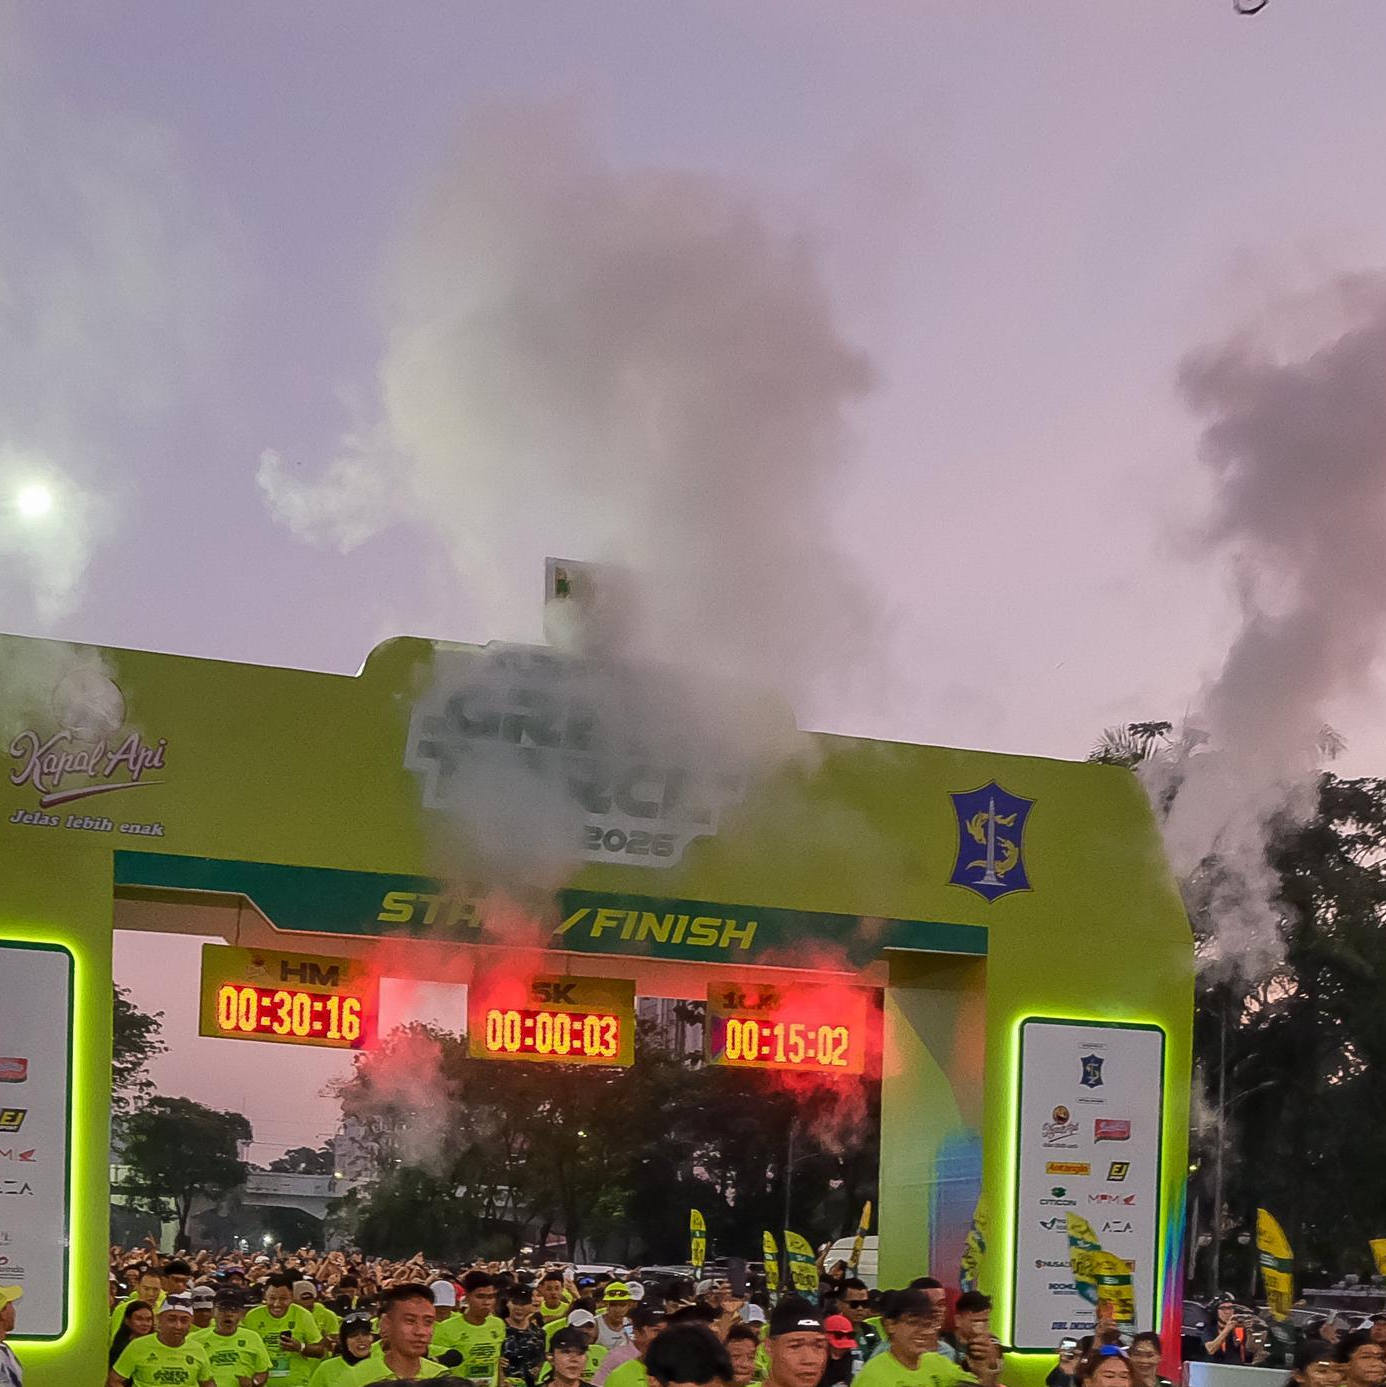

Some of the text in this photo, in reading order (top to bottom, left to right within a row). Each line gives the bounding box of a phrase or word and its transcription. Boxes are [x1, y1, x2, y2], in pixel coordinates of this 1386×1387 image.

[10, 729, 168, 794] Kapal Api
[10, 809, 165, 837] Jelas lebih enak
[280, 959, 340, 987] HM
[531, 981, 577, 1005] 5K
[218, 985, 362, 1041] 00:30:16
[486, 1009, 618, 1057] 00:00:03
[725, 1018, 851, 1067] 00:15:02
[0, 1111, 24, 1126] EJ
